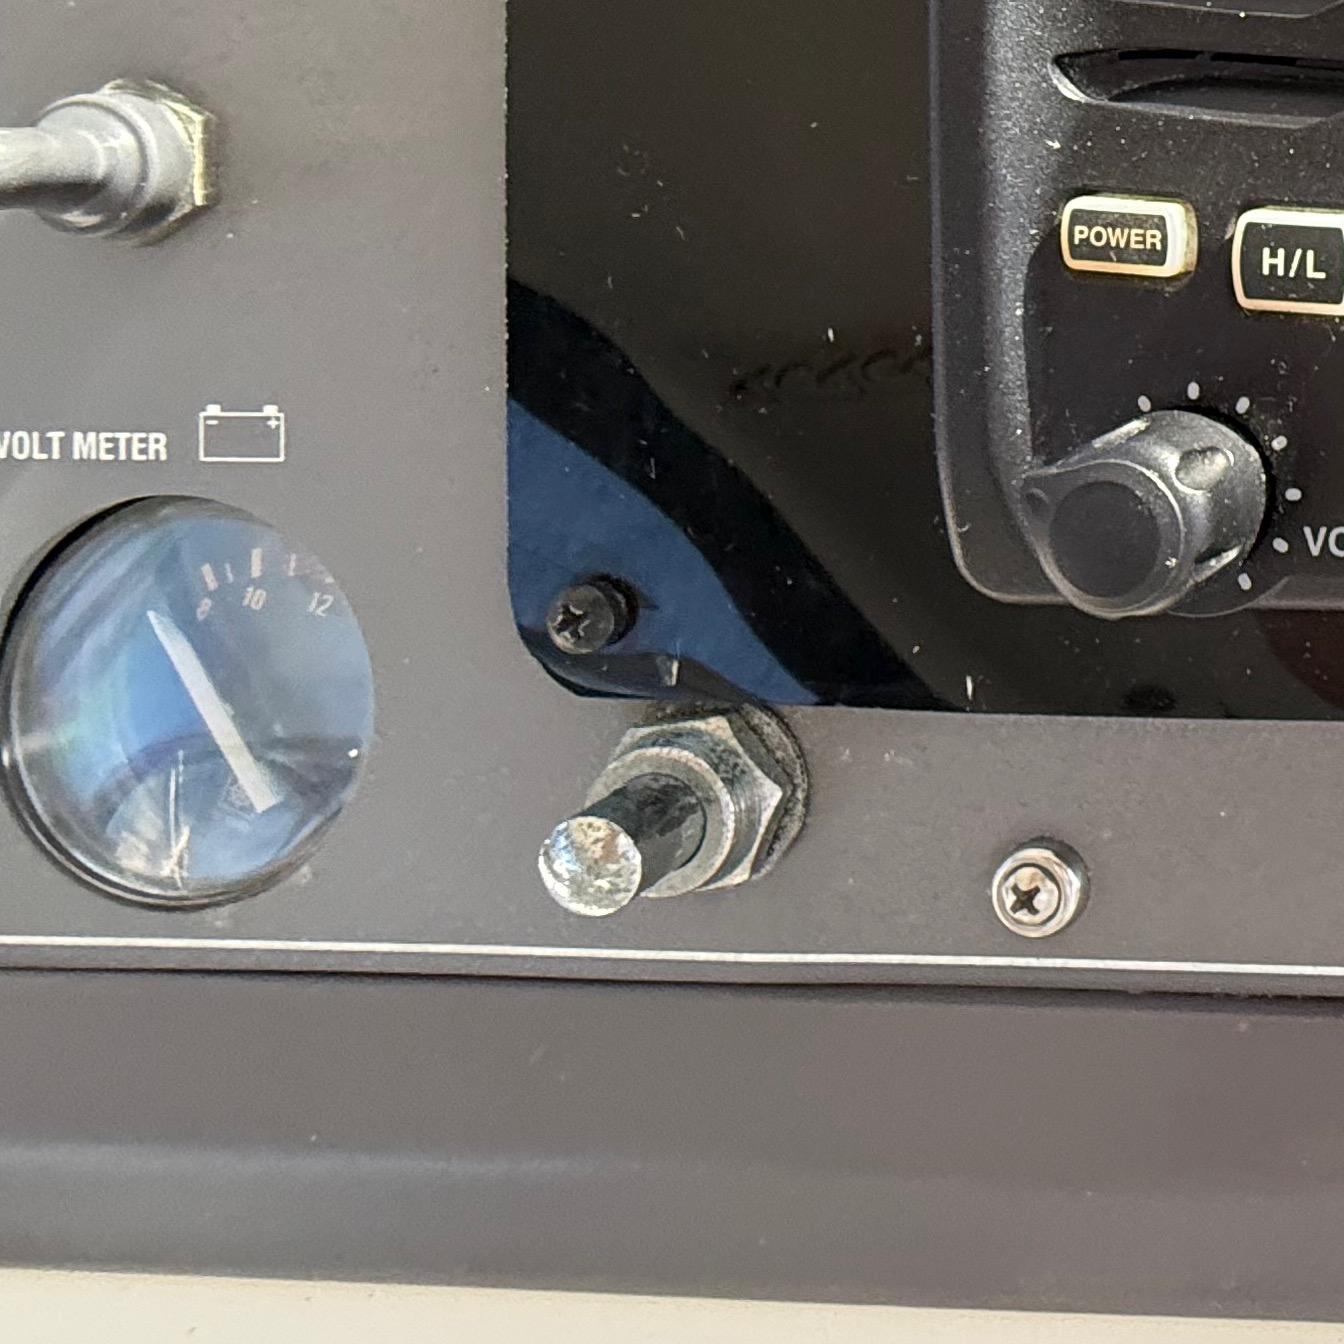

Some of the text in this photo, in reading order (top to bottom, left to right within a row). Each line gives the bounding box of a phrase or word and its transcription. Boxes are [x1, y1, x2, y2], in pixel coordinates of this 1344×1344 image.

[1072, 225, 1163, 251] POWER
[1261, 246, 1327, 280] H/L
[72, 431, 168, 461] METER
[242, 586, 267, 610] 10
[306, 591, 335, 617] 12
